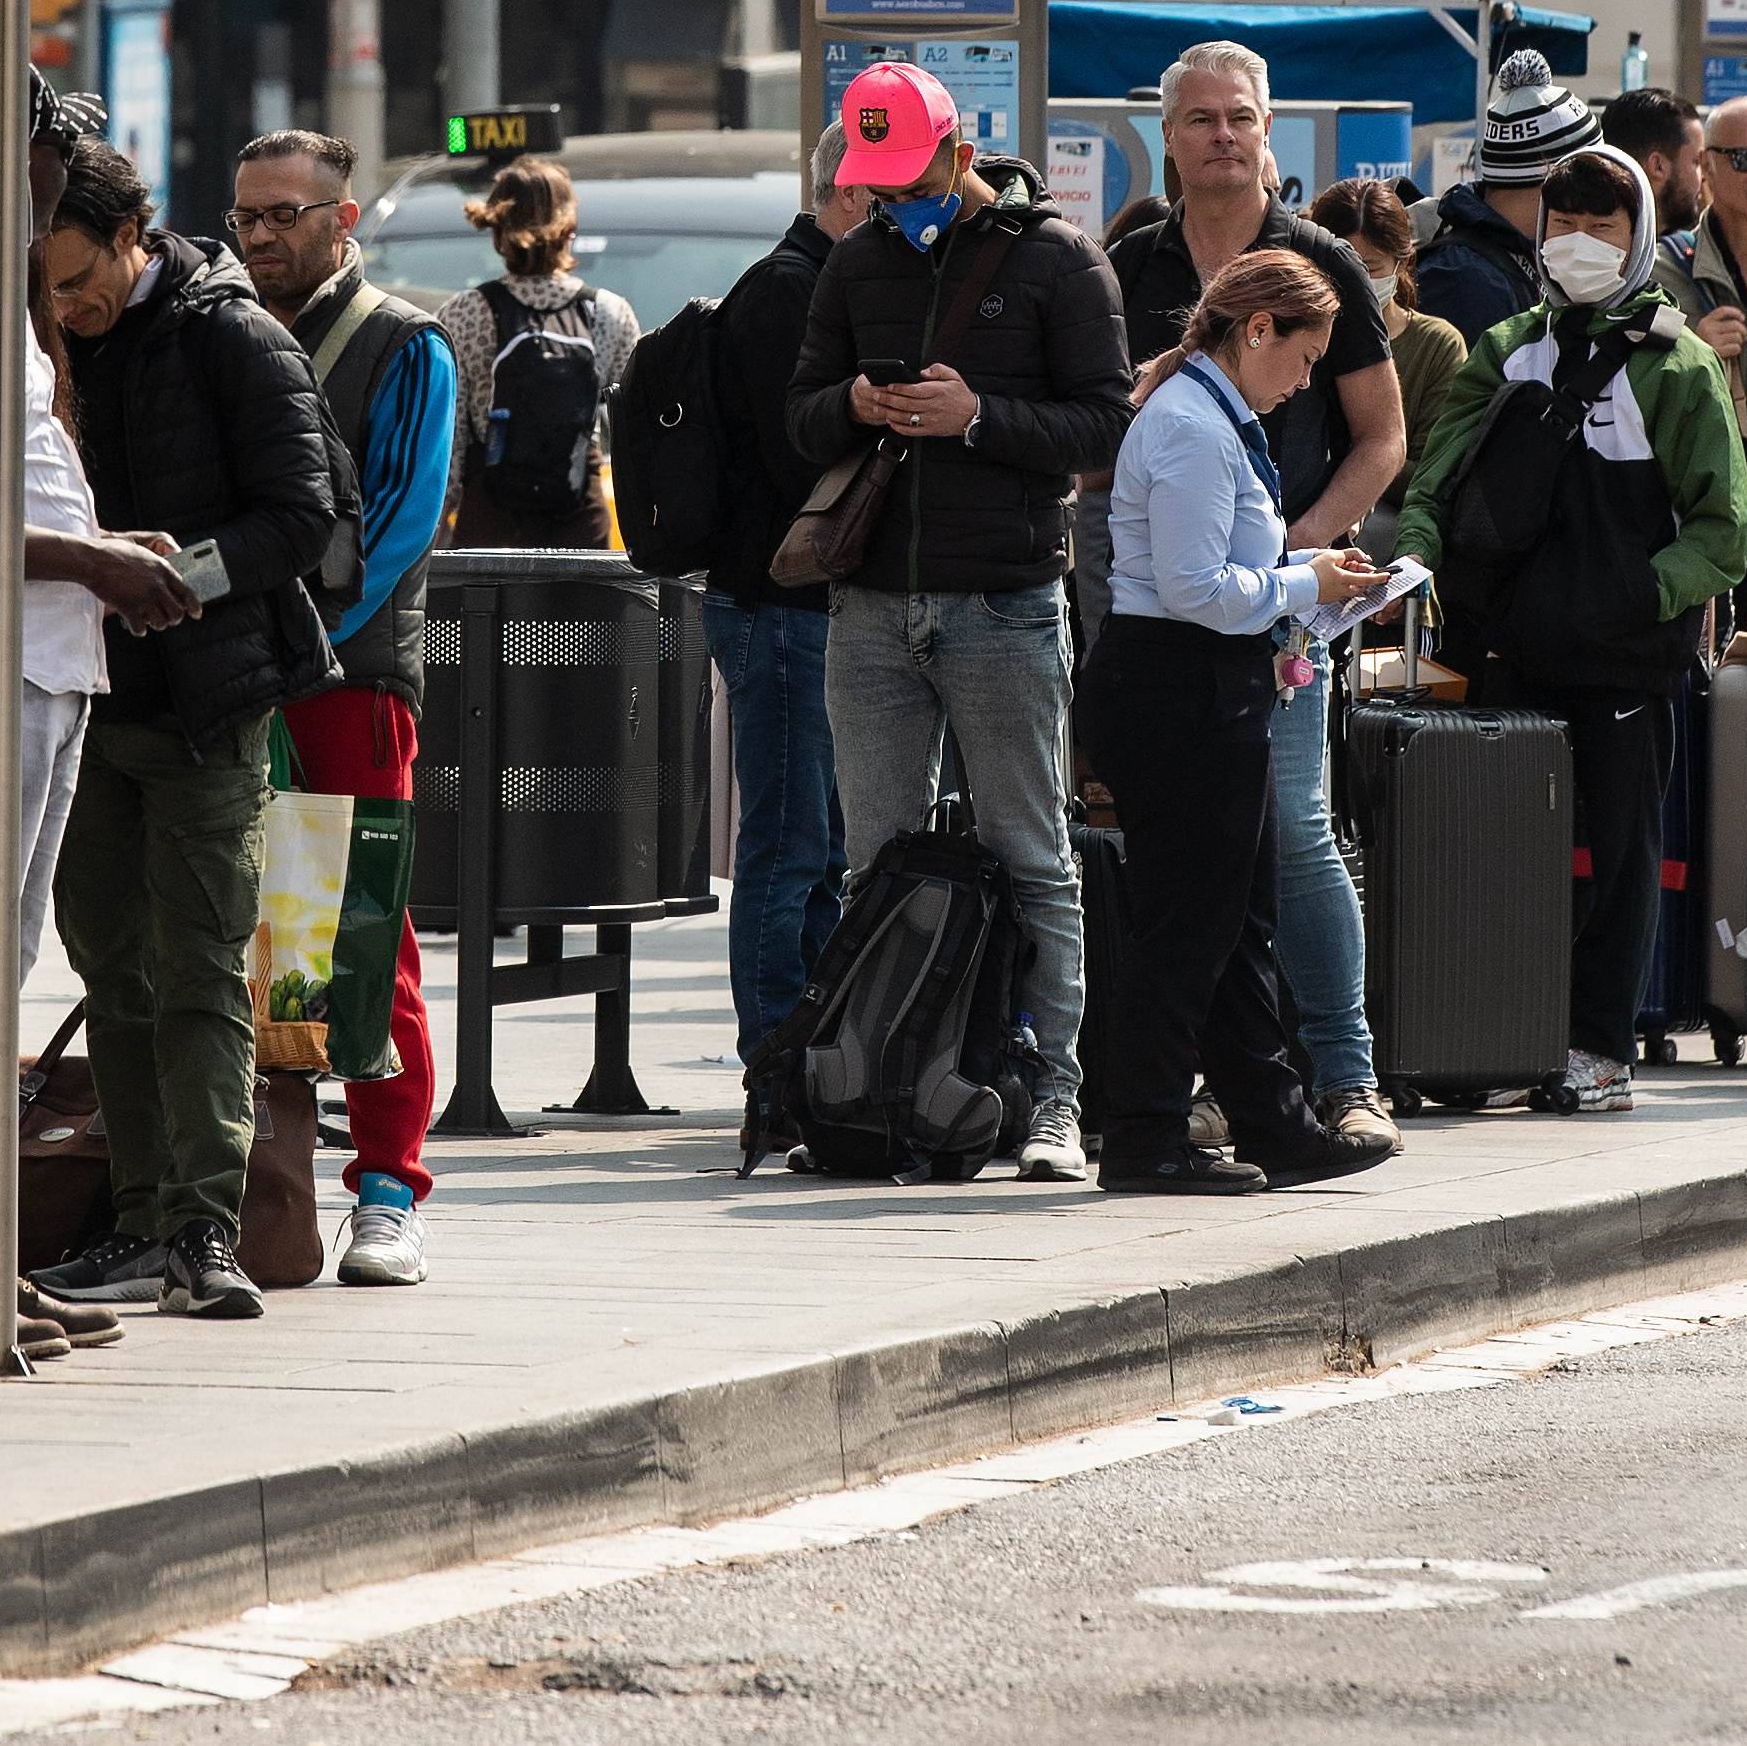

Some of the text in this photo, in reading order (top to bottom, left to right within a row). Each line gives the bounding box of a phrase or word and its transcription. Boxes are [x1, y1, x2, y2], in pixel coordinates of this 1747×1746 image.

[825, 45, 847, 61] A1
[923, 47, 948, 63] A2
[468, 116, 526, 150] TAXI
